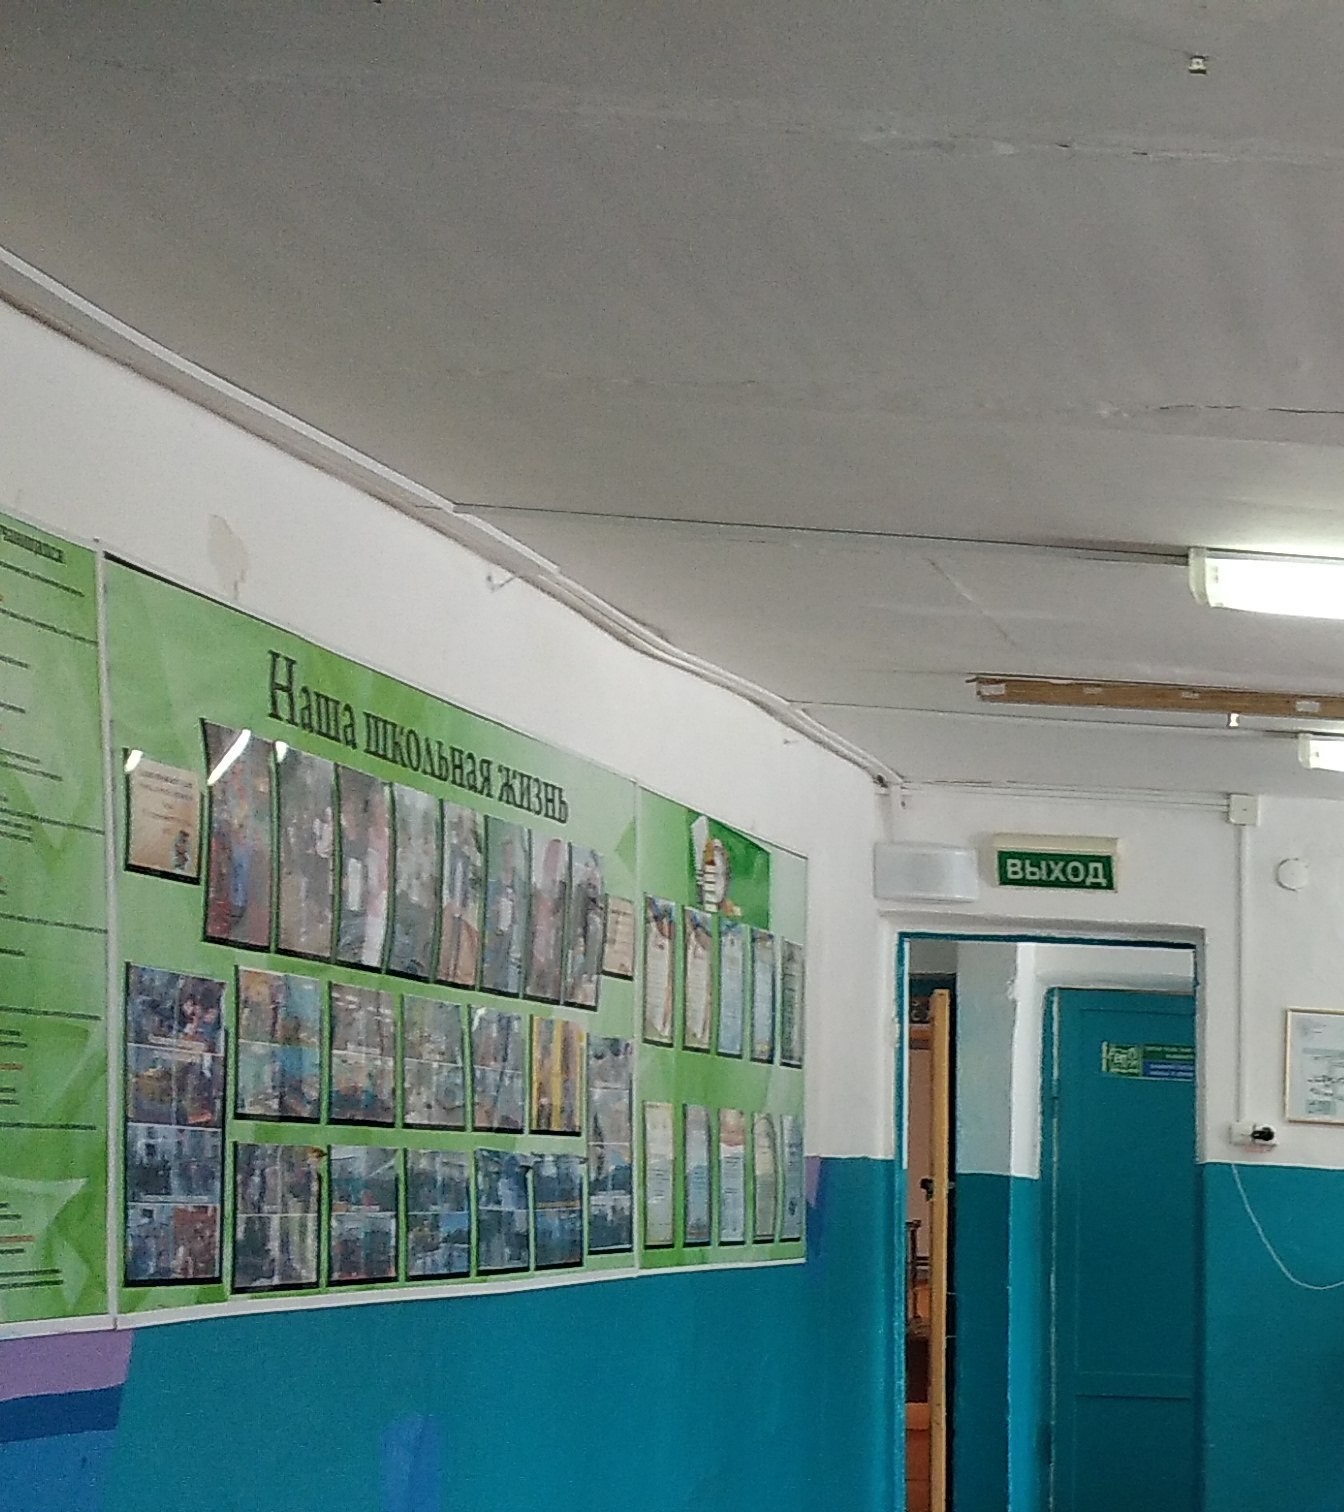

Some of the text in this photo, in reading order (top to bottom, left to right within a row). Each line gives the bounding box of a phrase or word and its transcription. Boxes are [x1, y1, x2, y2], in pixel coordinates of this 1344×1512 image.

[266, 649, 570, 824] Наша школьная жизнь
[1006, 858, 1107, 887] ВЫХОД
